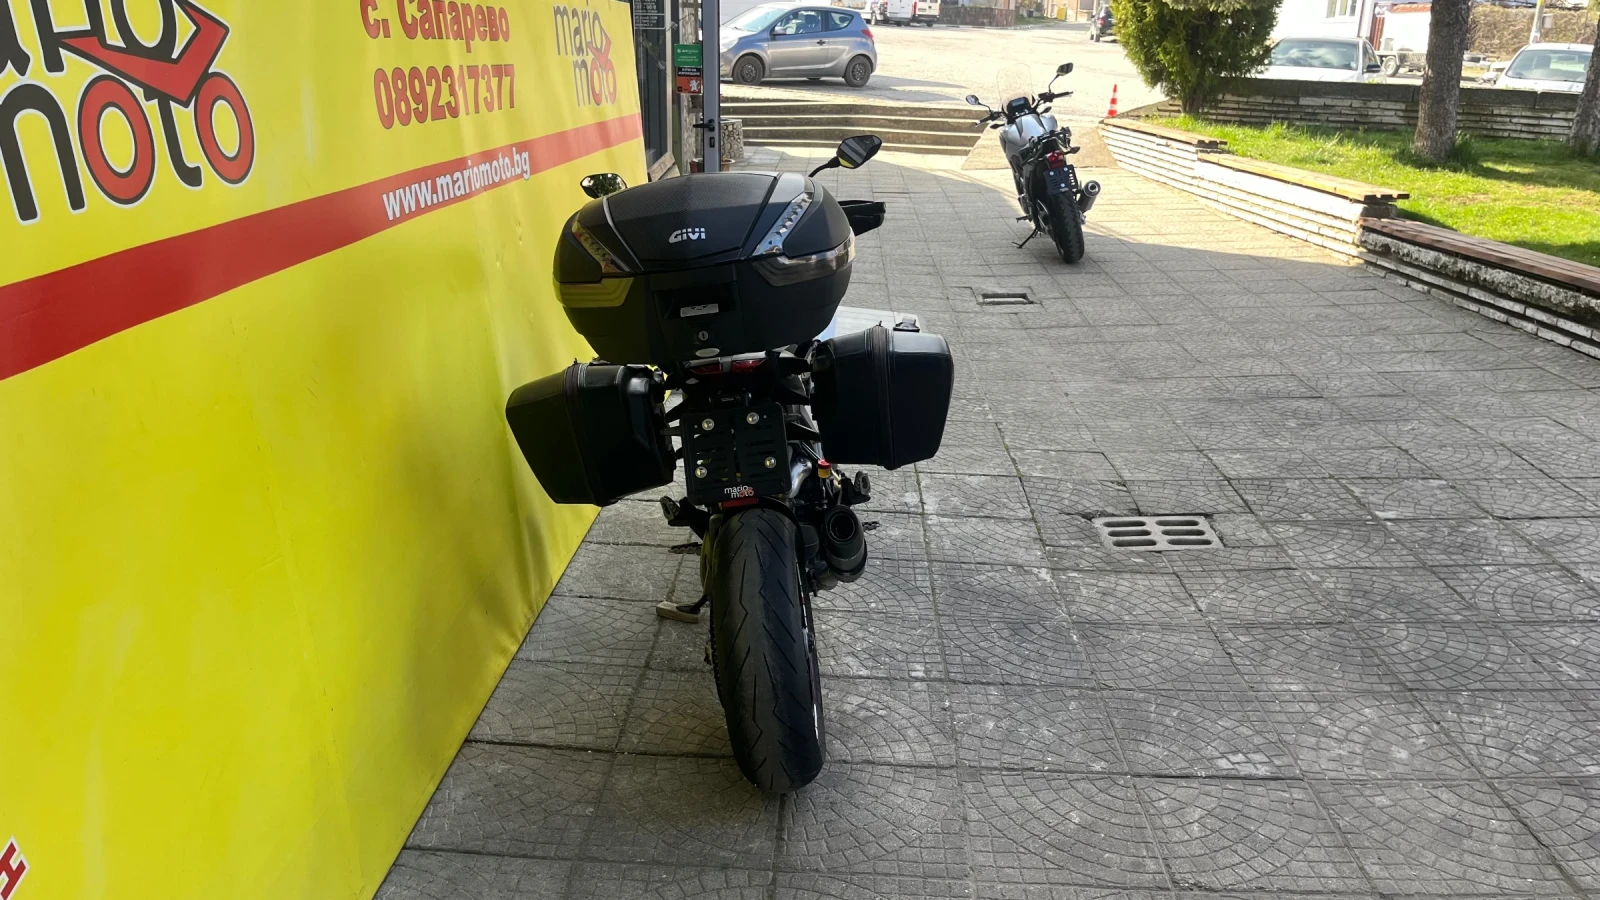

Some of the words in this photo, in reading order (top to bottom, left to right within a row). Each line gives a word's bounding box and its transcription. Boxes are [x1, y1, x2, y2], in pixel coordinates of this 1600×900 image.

[397, 0, 510, 54] Сапарево
[553, 1, 604, 57] mario
[374, 64, 515, 129] 0892317377
[573, 58, 617, 107] moto
[382, 147, 531, 221] www.mariomoto.bg
[668, 227, 706, 243] GIVI
[724, 485, 748, 494] mario
[731, 489, 754, 499] moto
